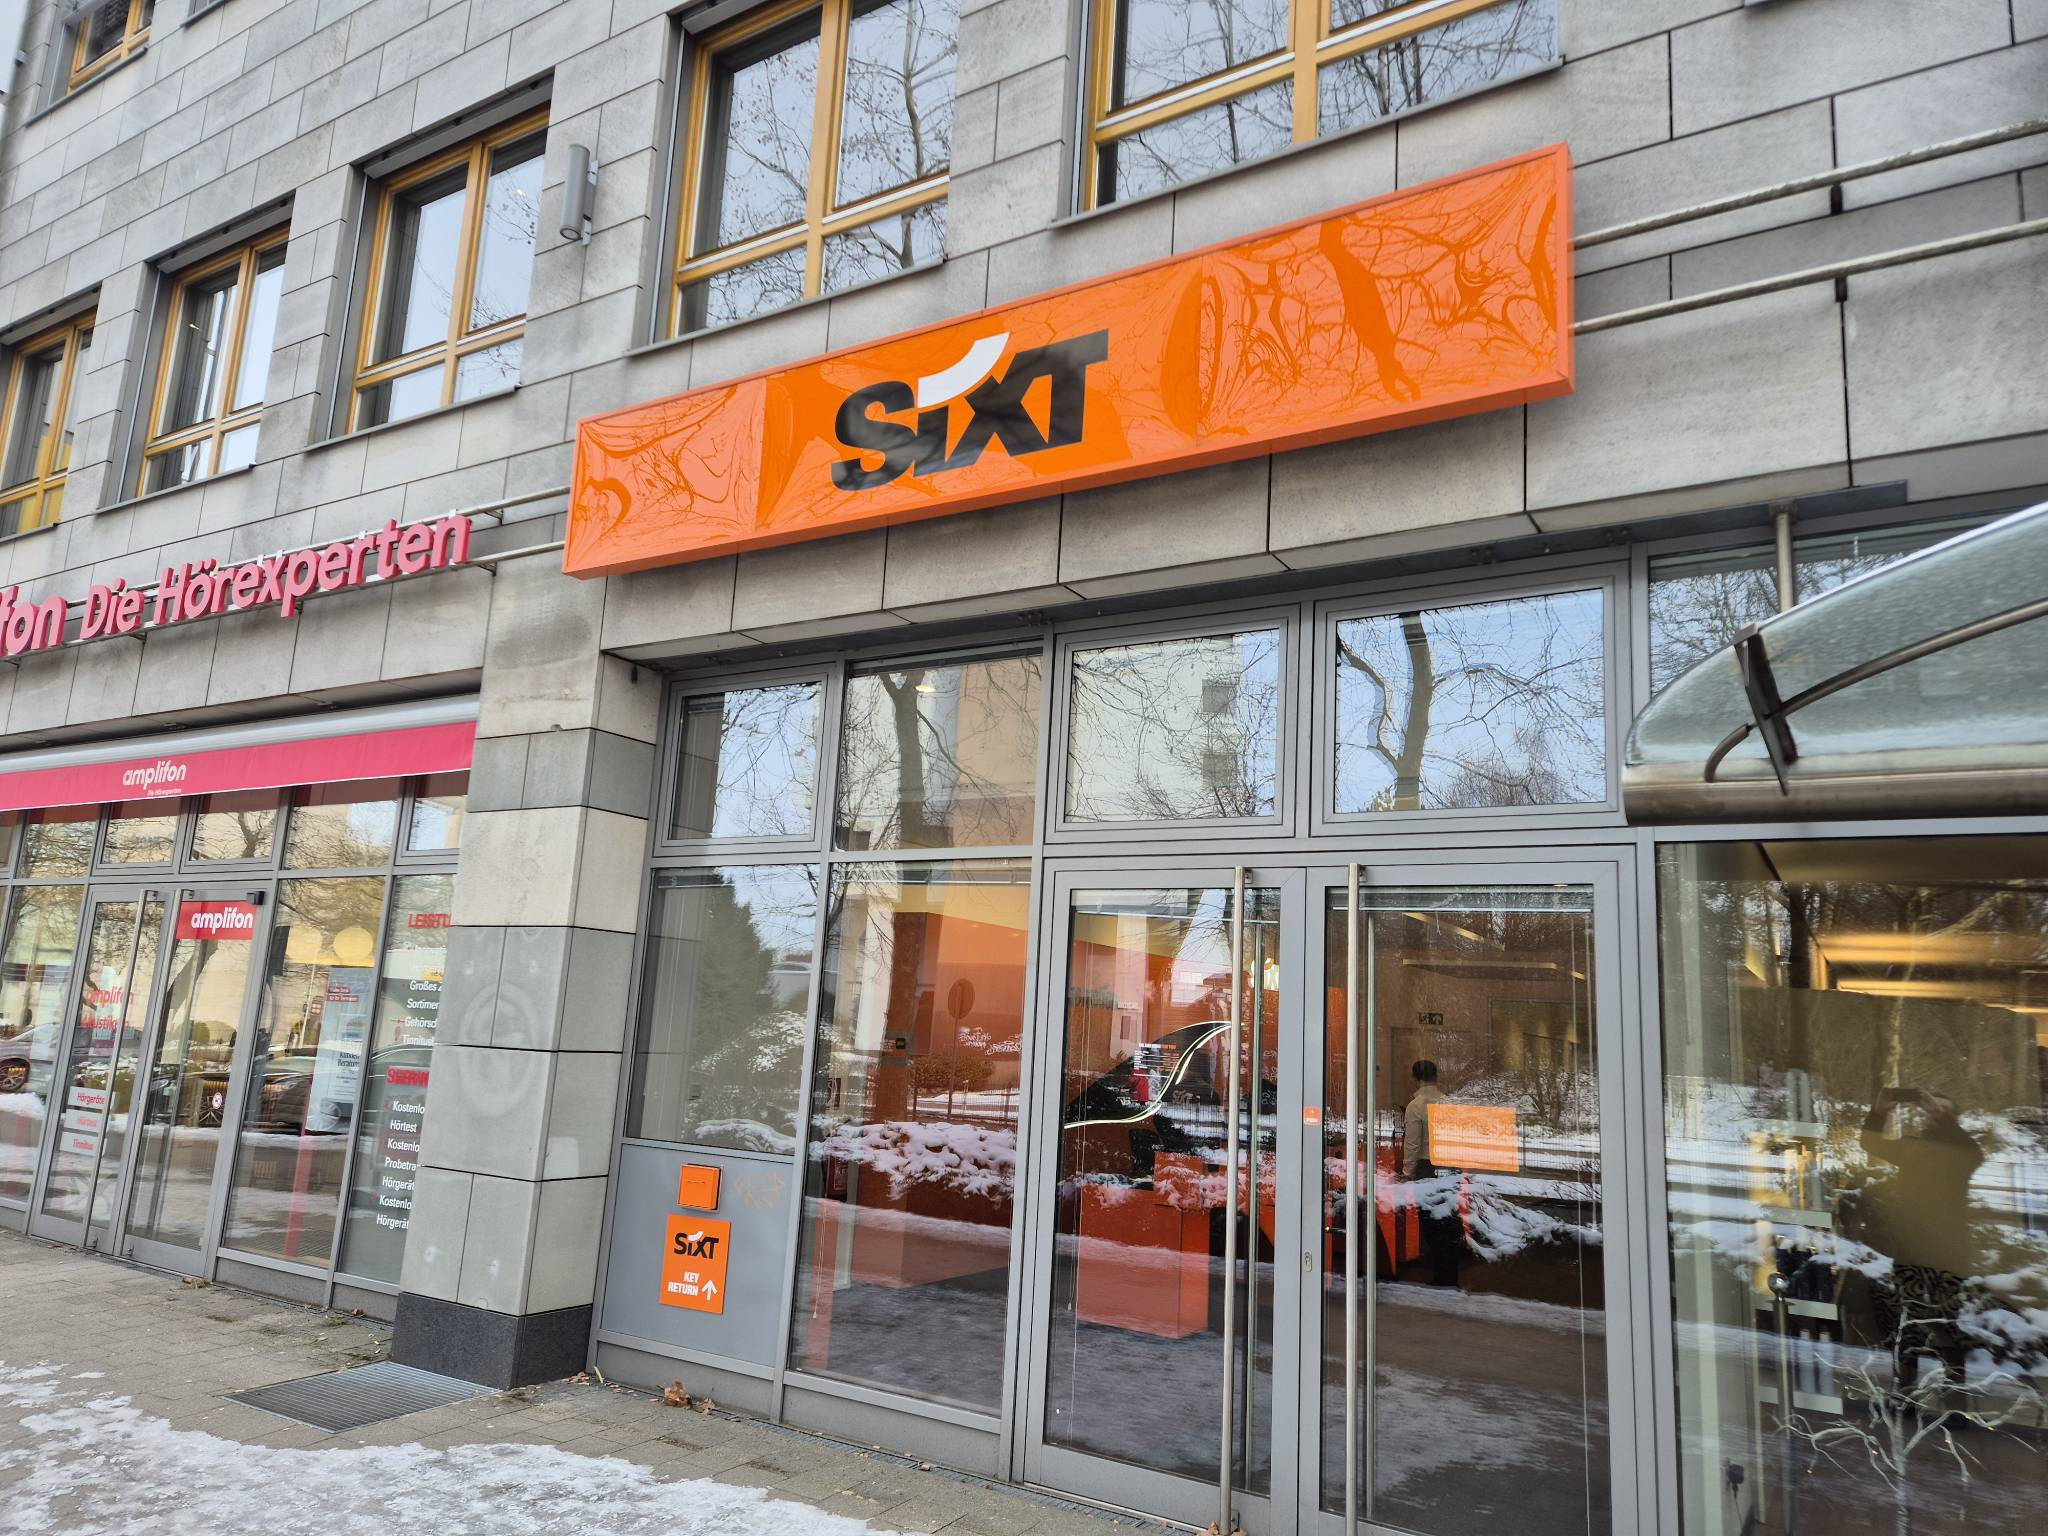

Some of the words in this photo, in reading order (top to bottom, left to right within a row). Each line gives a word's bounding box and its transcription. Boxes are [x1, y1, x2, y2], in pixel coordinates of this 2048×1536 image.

[79, 577, 145, 640] Die
[153, 514, 472, 625] Hörexperten
[122, 760, 187, 790] amplifon
[190, 906, 254, 935] amplifon
[409, 980, 437, 992] Großes
[392, 1101, 425, 1115] Kostenlo
[389, 1119, 418, 1133] Hörtest
[387, 1138, 420, 1153] Kostenlo
[379, 1194, 412, 1210] Kostenlo
[683, 1271, 700, 1284] KEY
[668, 1281, 699, 1296] RETURN
